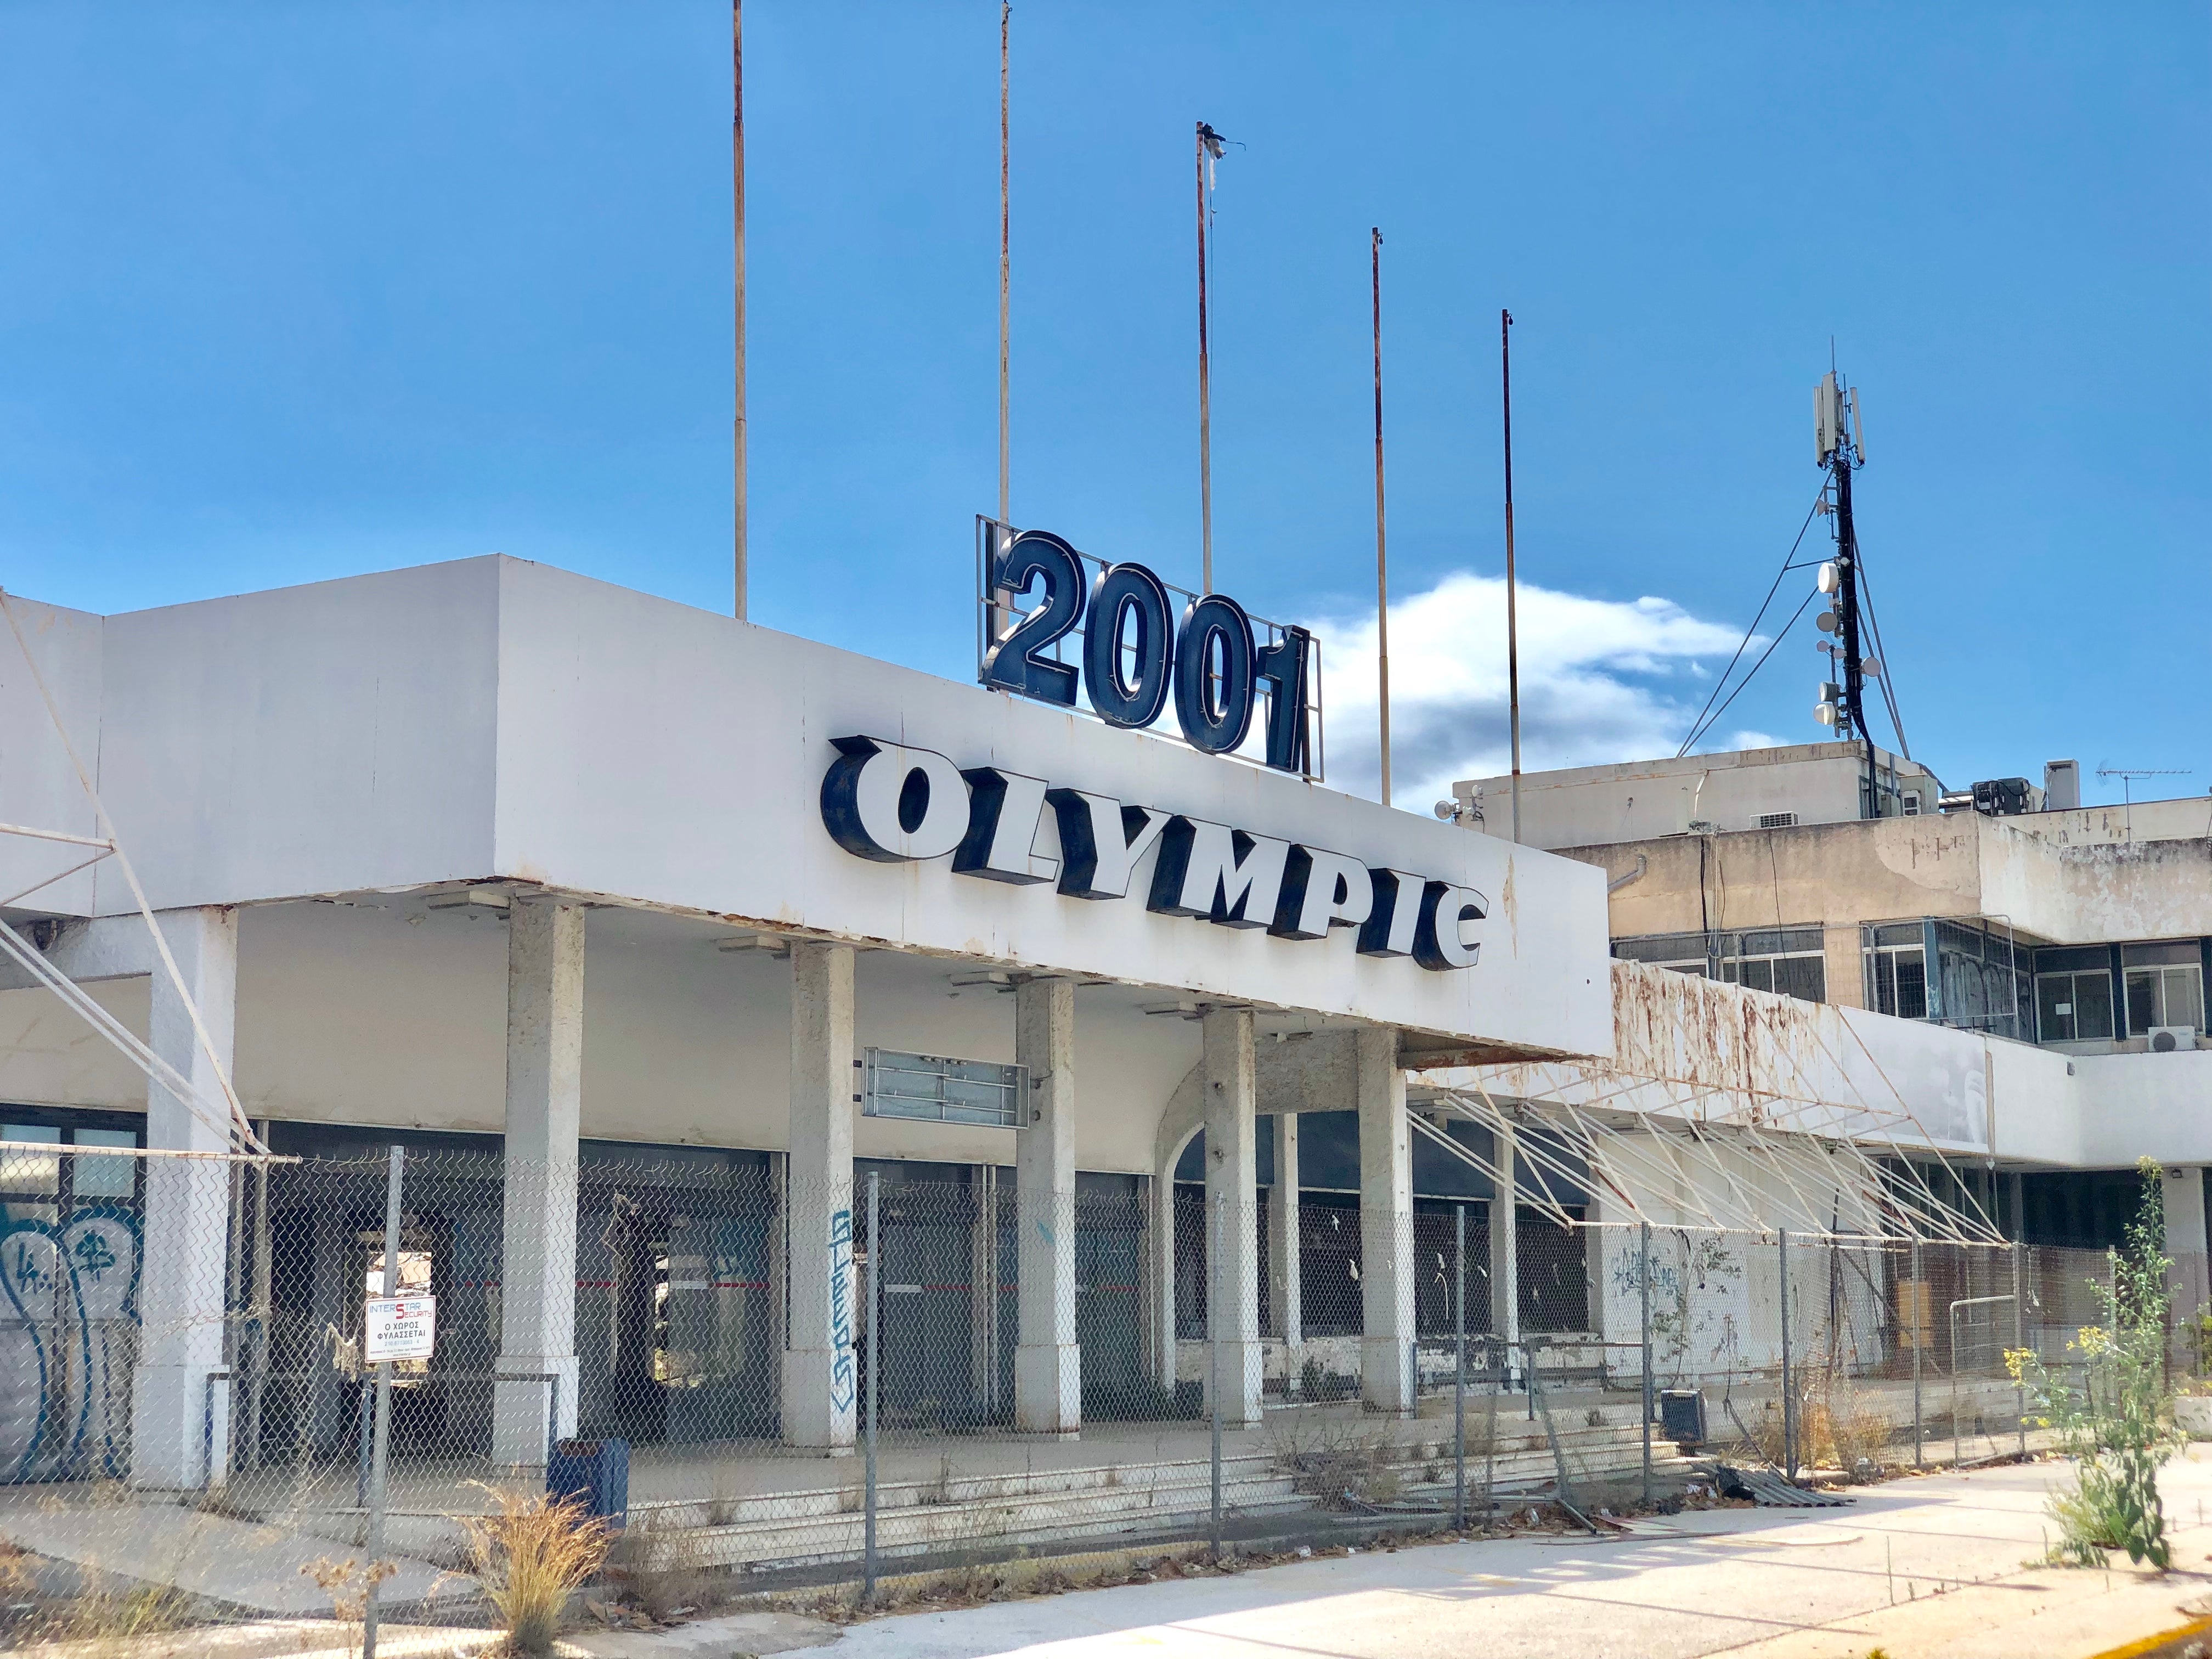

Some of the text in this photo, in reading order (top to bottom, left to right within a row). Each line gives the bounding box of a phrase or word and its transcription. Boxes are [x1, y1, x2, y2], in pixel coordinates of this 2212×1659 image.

[978, 529, 1311, 772] 2001
[820, 735, 1489, 972] OLYMPIC
[377, 1329, 426, 1340] ΦΥΛΑΣΣΕΤΑΙ
[393, 1321, 419, 1330] ΧΩΡΟΣ
